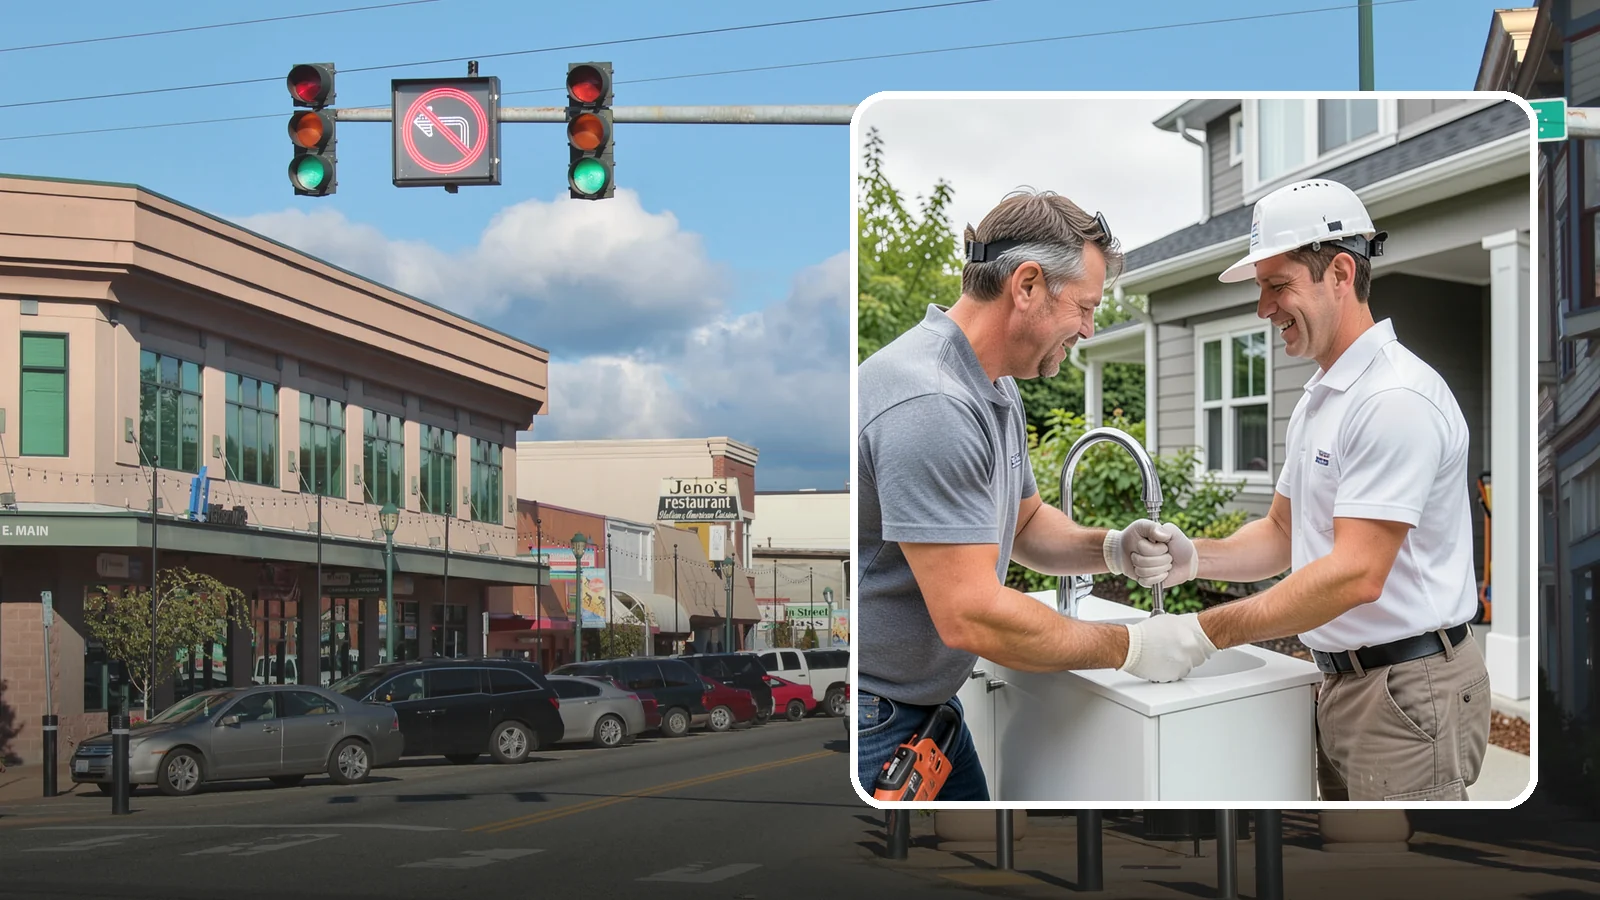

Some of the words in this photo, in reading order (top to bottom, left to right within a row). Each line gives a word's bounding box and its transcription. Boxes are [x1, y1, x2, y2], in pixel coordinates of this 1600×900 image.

[669, 480, 727, 494] Jeno's
[665, 496, 731, 509] restaurant
[658, 509, 681, 519] Italian
[686, 509, 714, 519] American
[715, 509, 738, 519] Cuisine
[2, 525, 13, 536] E.
[15, 525, 49, 536] MAIN
[797, 607, 829, 617] Street
[790, 619, 824, 627] lass
